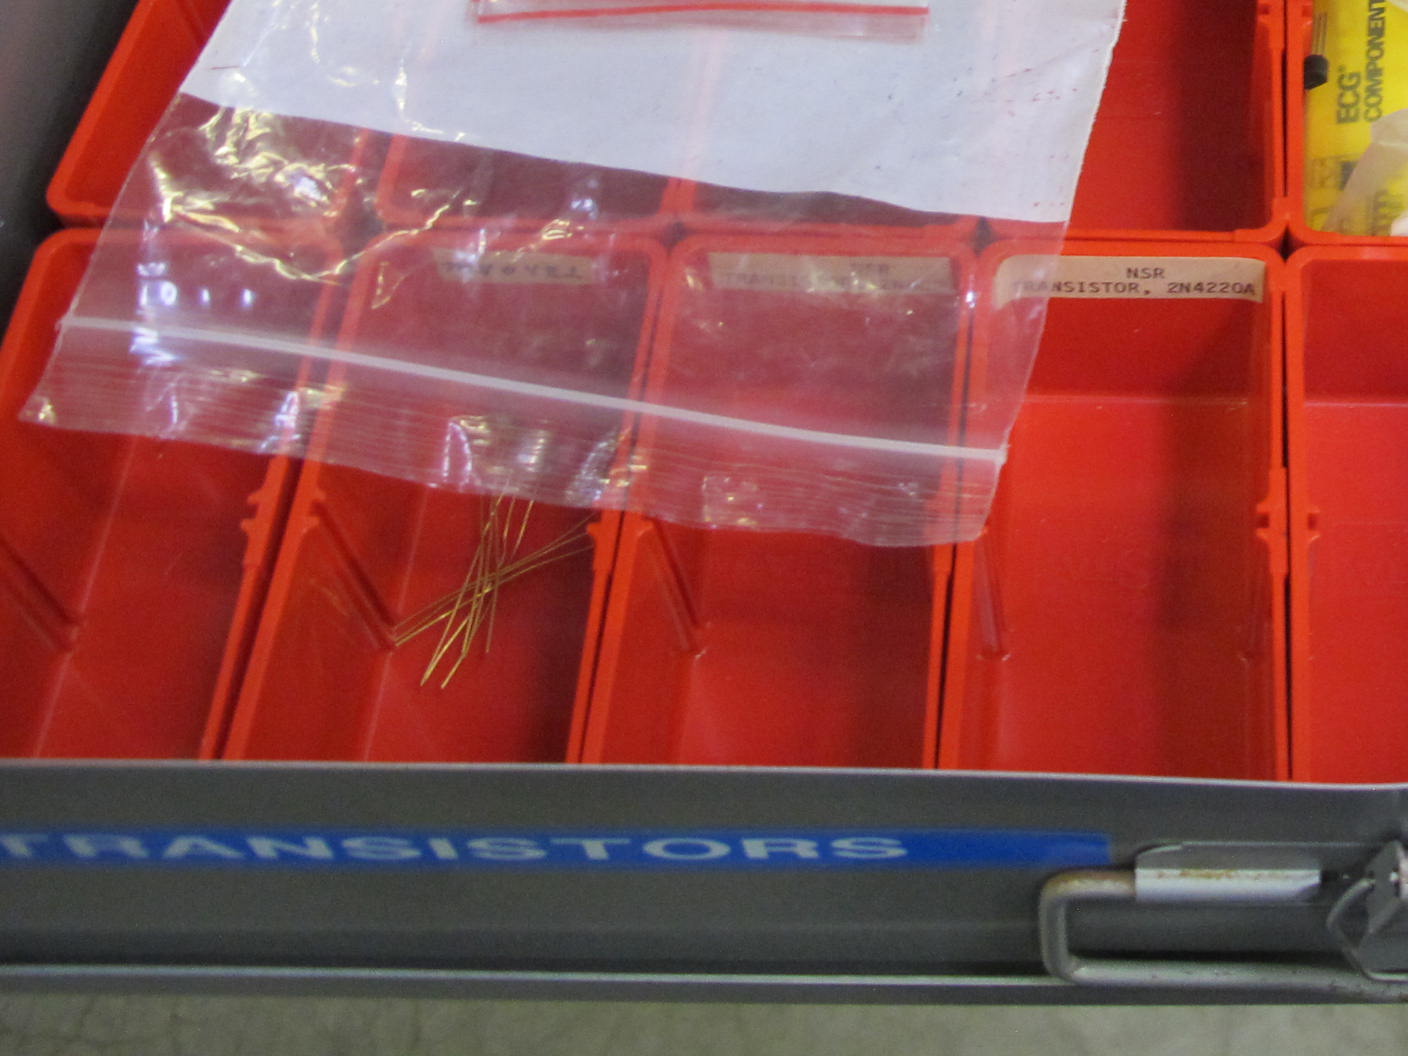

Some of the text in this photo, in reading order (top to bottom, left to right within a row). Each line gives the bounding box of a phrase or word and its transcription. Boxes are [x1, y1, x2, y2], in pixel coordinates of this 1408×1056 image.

[1126, 267, 1165, 279] NSR
[1167, 282, 1255, 295] 2N4220A
[0, 832, 909, 861] TRANSISTORS
